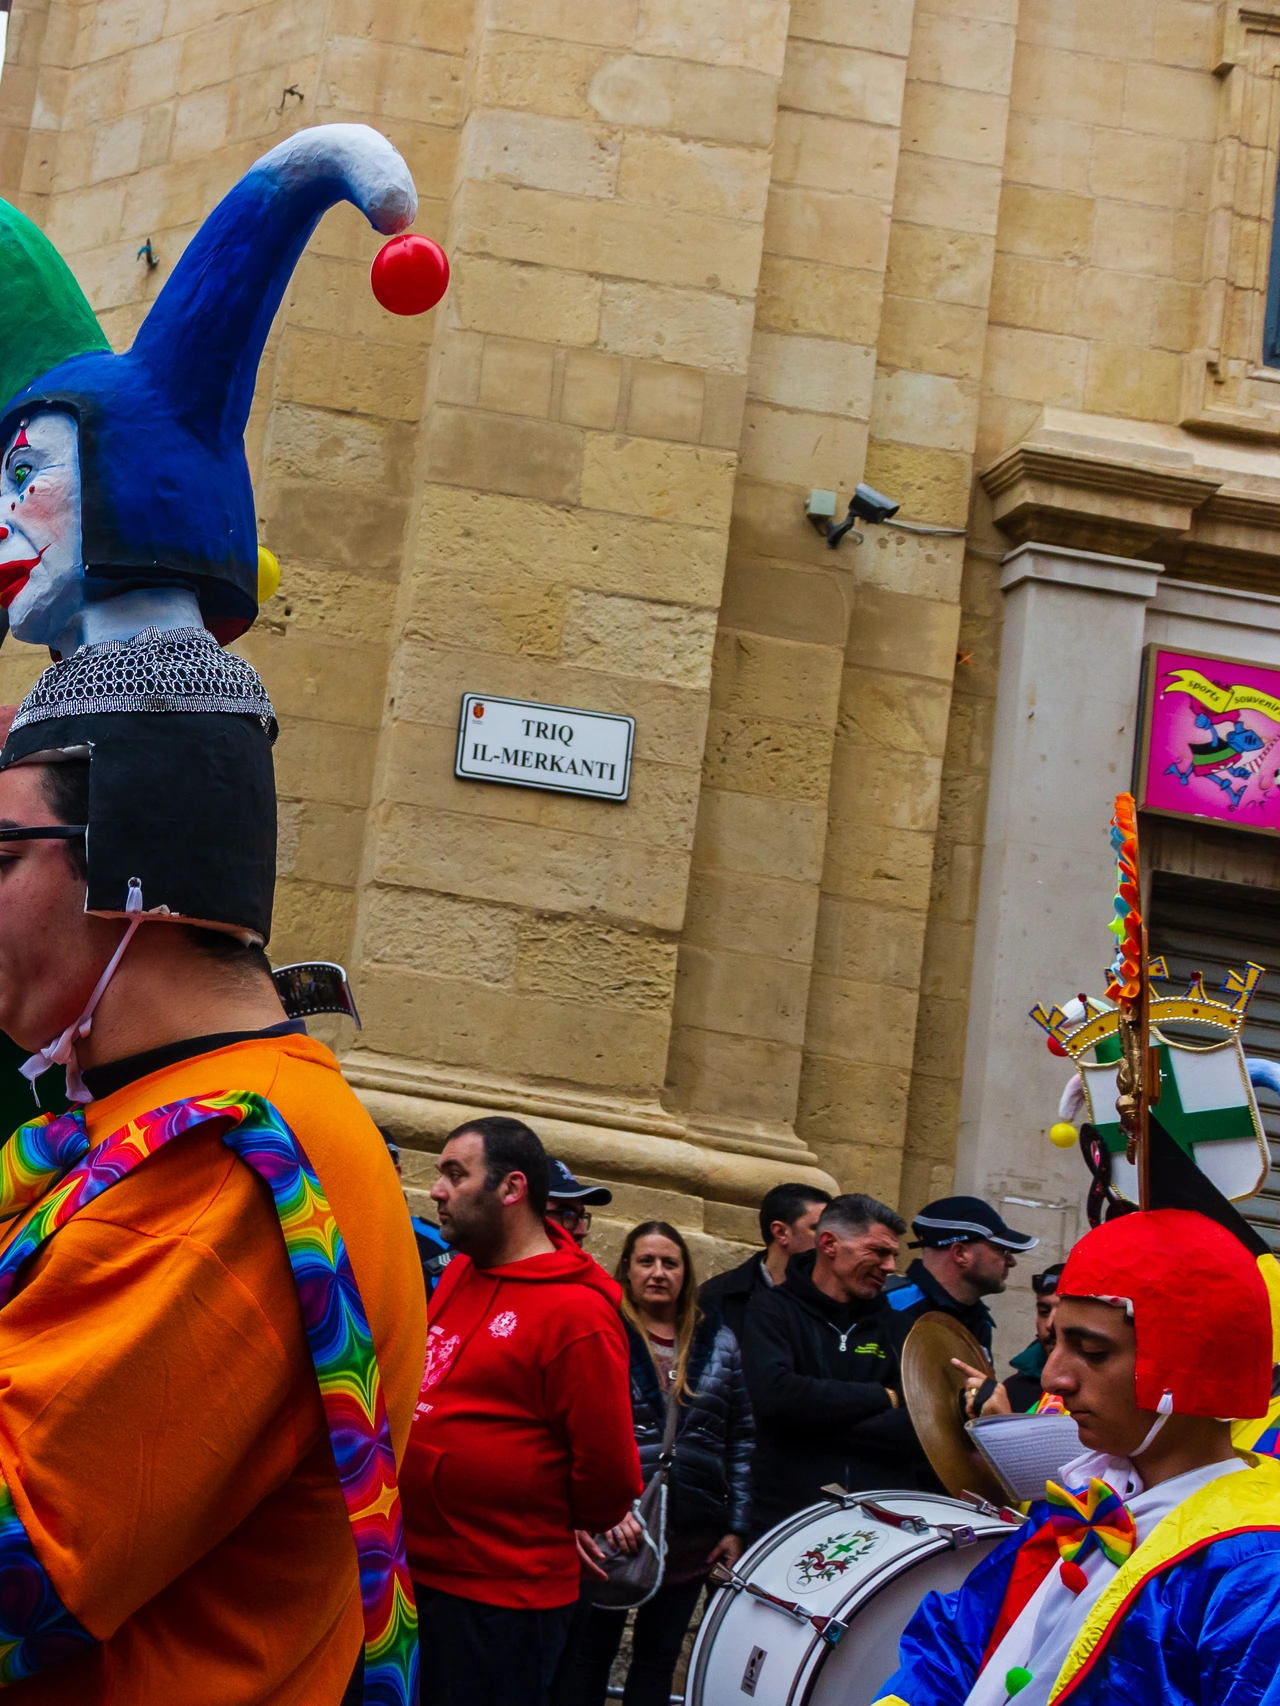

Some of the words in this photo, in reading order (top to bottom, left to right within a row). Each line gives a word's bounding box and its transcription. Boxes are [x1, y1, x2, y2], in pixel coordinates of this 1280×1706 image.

[1188, 680, 1220, 702] sports
[522, 718, 574, 747] TRIQ
[472, 743, 617, 781] IL-MERKANTI
